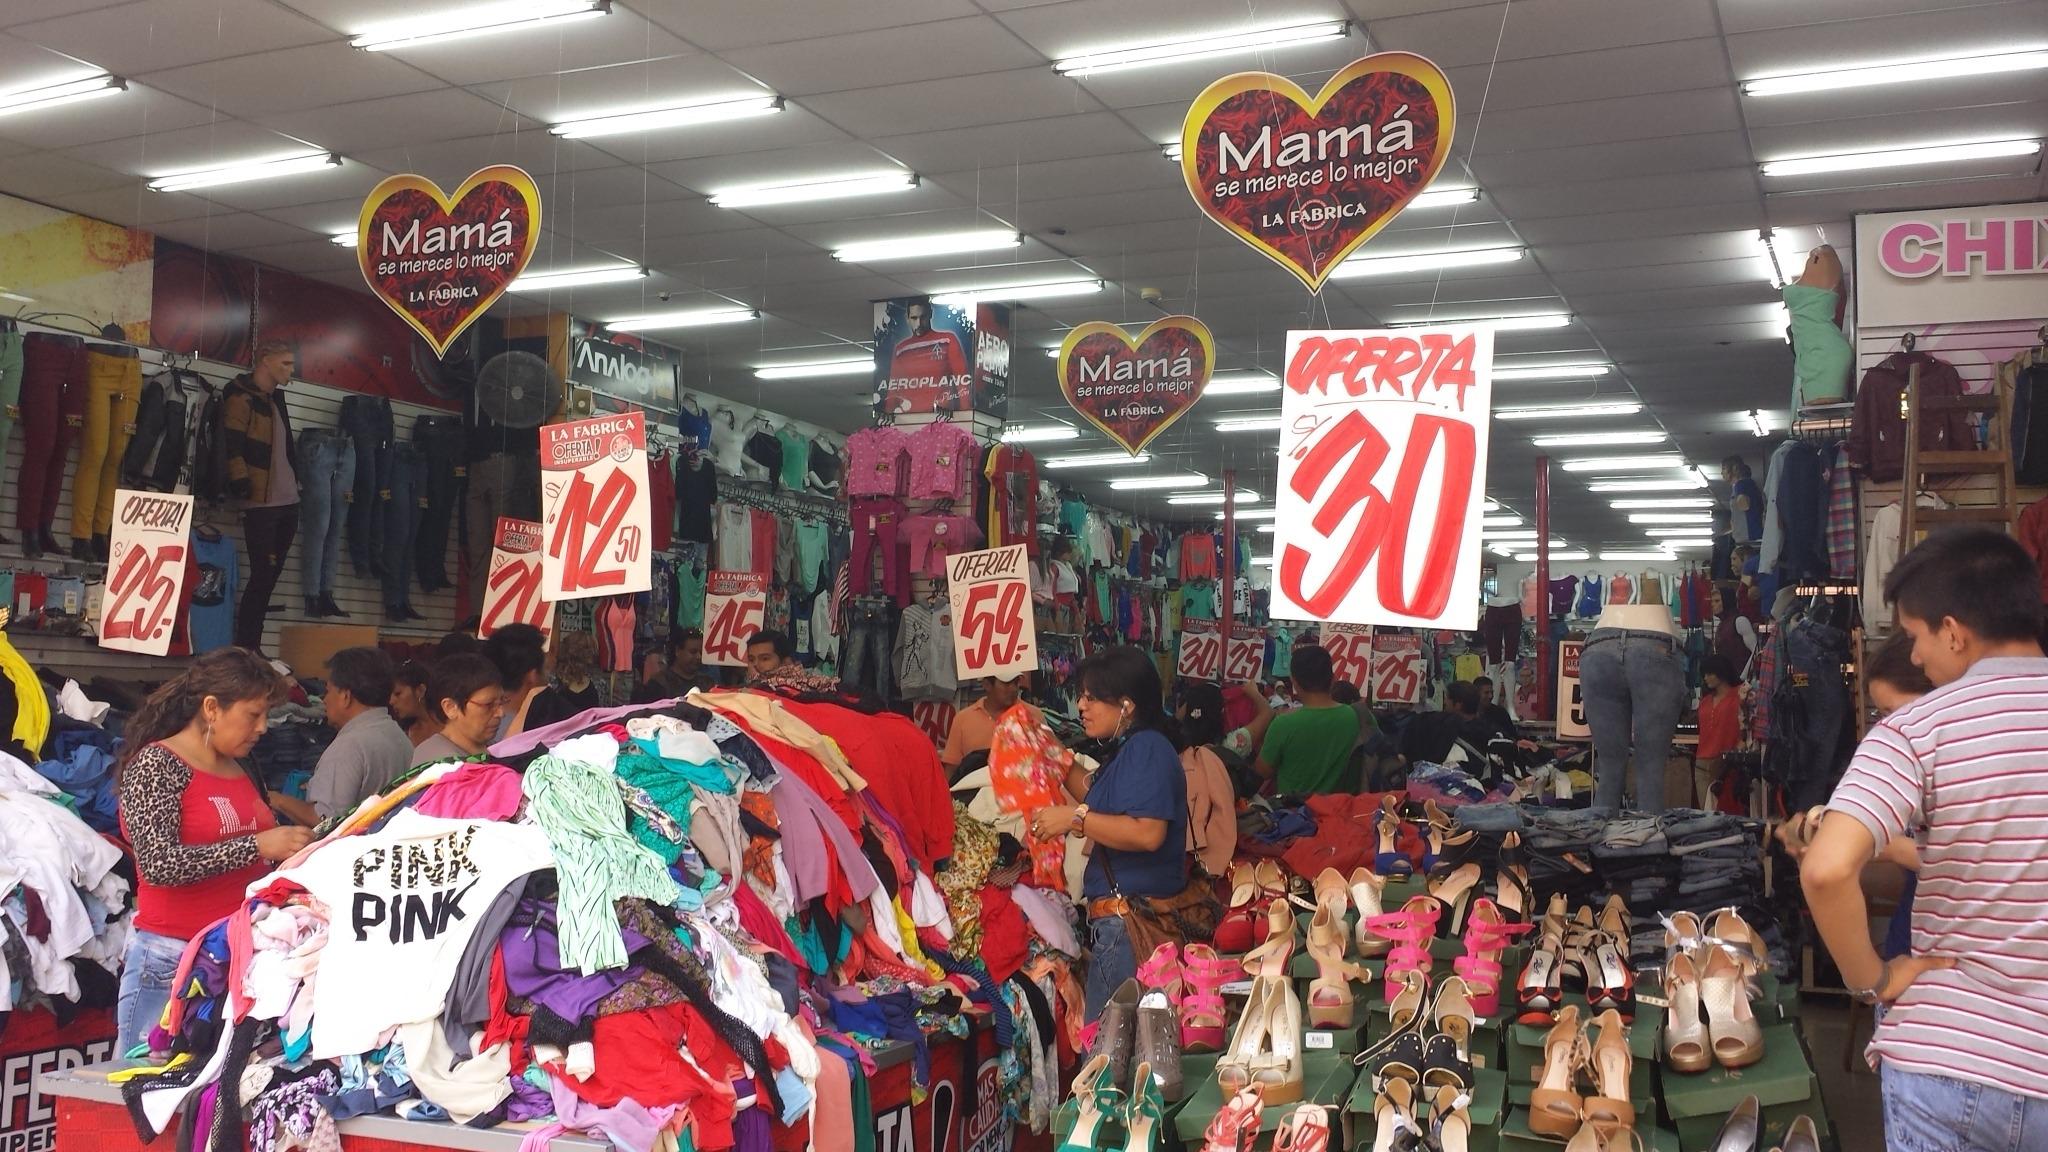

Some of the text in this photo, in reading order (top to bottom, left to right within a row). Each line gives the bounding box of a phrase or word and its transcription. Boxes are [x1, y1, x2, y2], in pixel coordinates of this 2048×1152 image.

[1218, 104, 1413, 174] Mamá
[1215, 154, 1418, 197] se merece lo mejor
[382, 208, 512, 256] Mamá
[1262, 203, 1367, 228] LA FABRICA
[378, 249, 514, 276] se merece lo mejor
[1878, 218, 2048, 277] CHI
[410, 286, 479, 302] LA FABRICA
[1079, 348, 1192, 383] Mamá
[1286, 333, 1476, 411] OFERTA
[1077, 378, 1194, 396] se merece lo mejor
[551, 418, 635, 442] LA FABRICA
[1104, 406, 1164, 417] LA FABRICA
[120, 495, 189, 533] OFERTA!
[504, 521, 516, 532] LA
[1280, 408, 1476, 619] 30
[615, 525, 641, 563] 50
[953, 547, 1022, 581] OFERTA!
[704, 598, 764, 664] 45
[1226, 642, 1264, 680] 25
[1566, 647, 1579, 657] LA
[1376, 654, 1420, 700] 25
[353, 825, 481, 889] PINK
[352, 876, 480, 945] PINK
